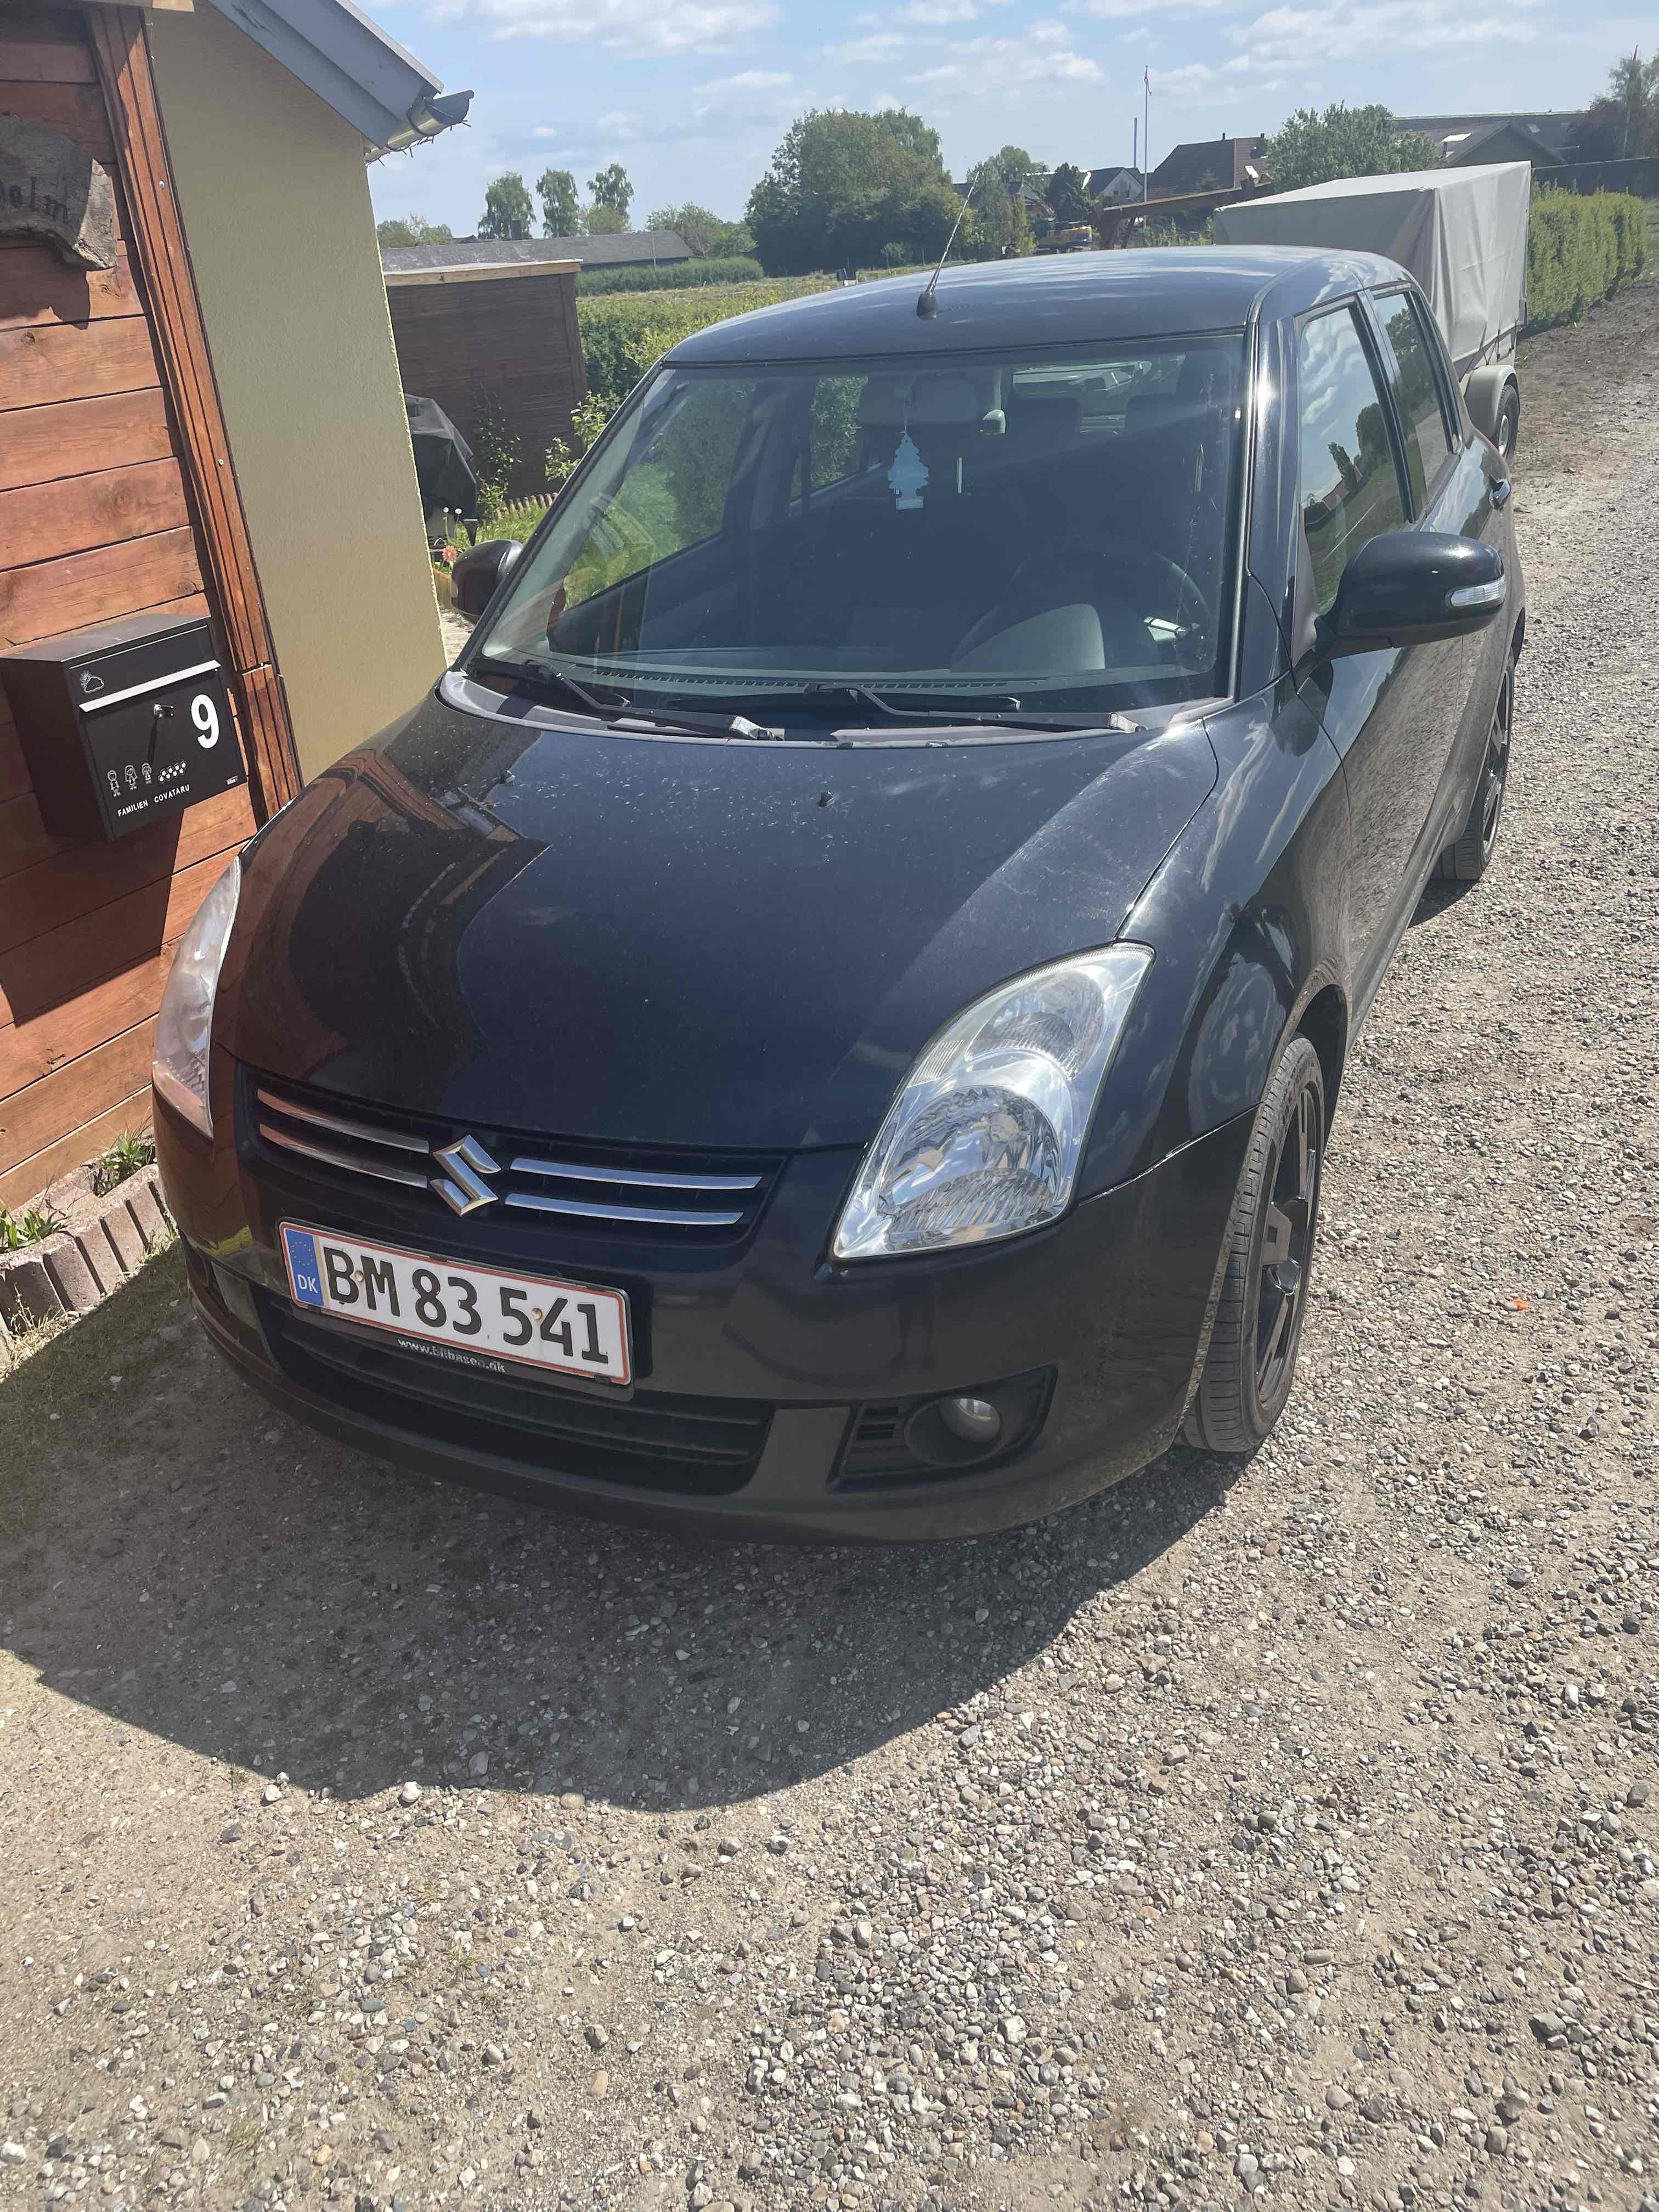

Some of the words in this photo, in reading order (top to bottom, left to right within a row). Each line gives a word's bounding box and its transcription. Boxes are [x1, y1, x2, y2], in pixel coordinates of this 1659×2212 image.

[191, 693, 219, 749] 9
[117, 799, 148, 816] FAMILIEN
[154, 785, 190, 803] COVATARU
[297, 1273, 318, 1294] DK
[324, 1246, 400, 1317] BM
[412, 1268, 482, 1335] 83
[500, 1286, 608, 1365] 541
